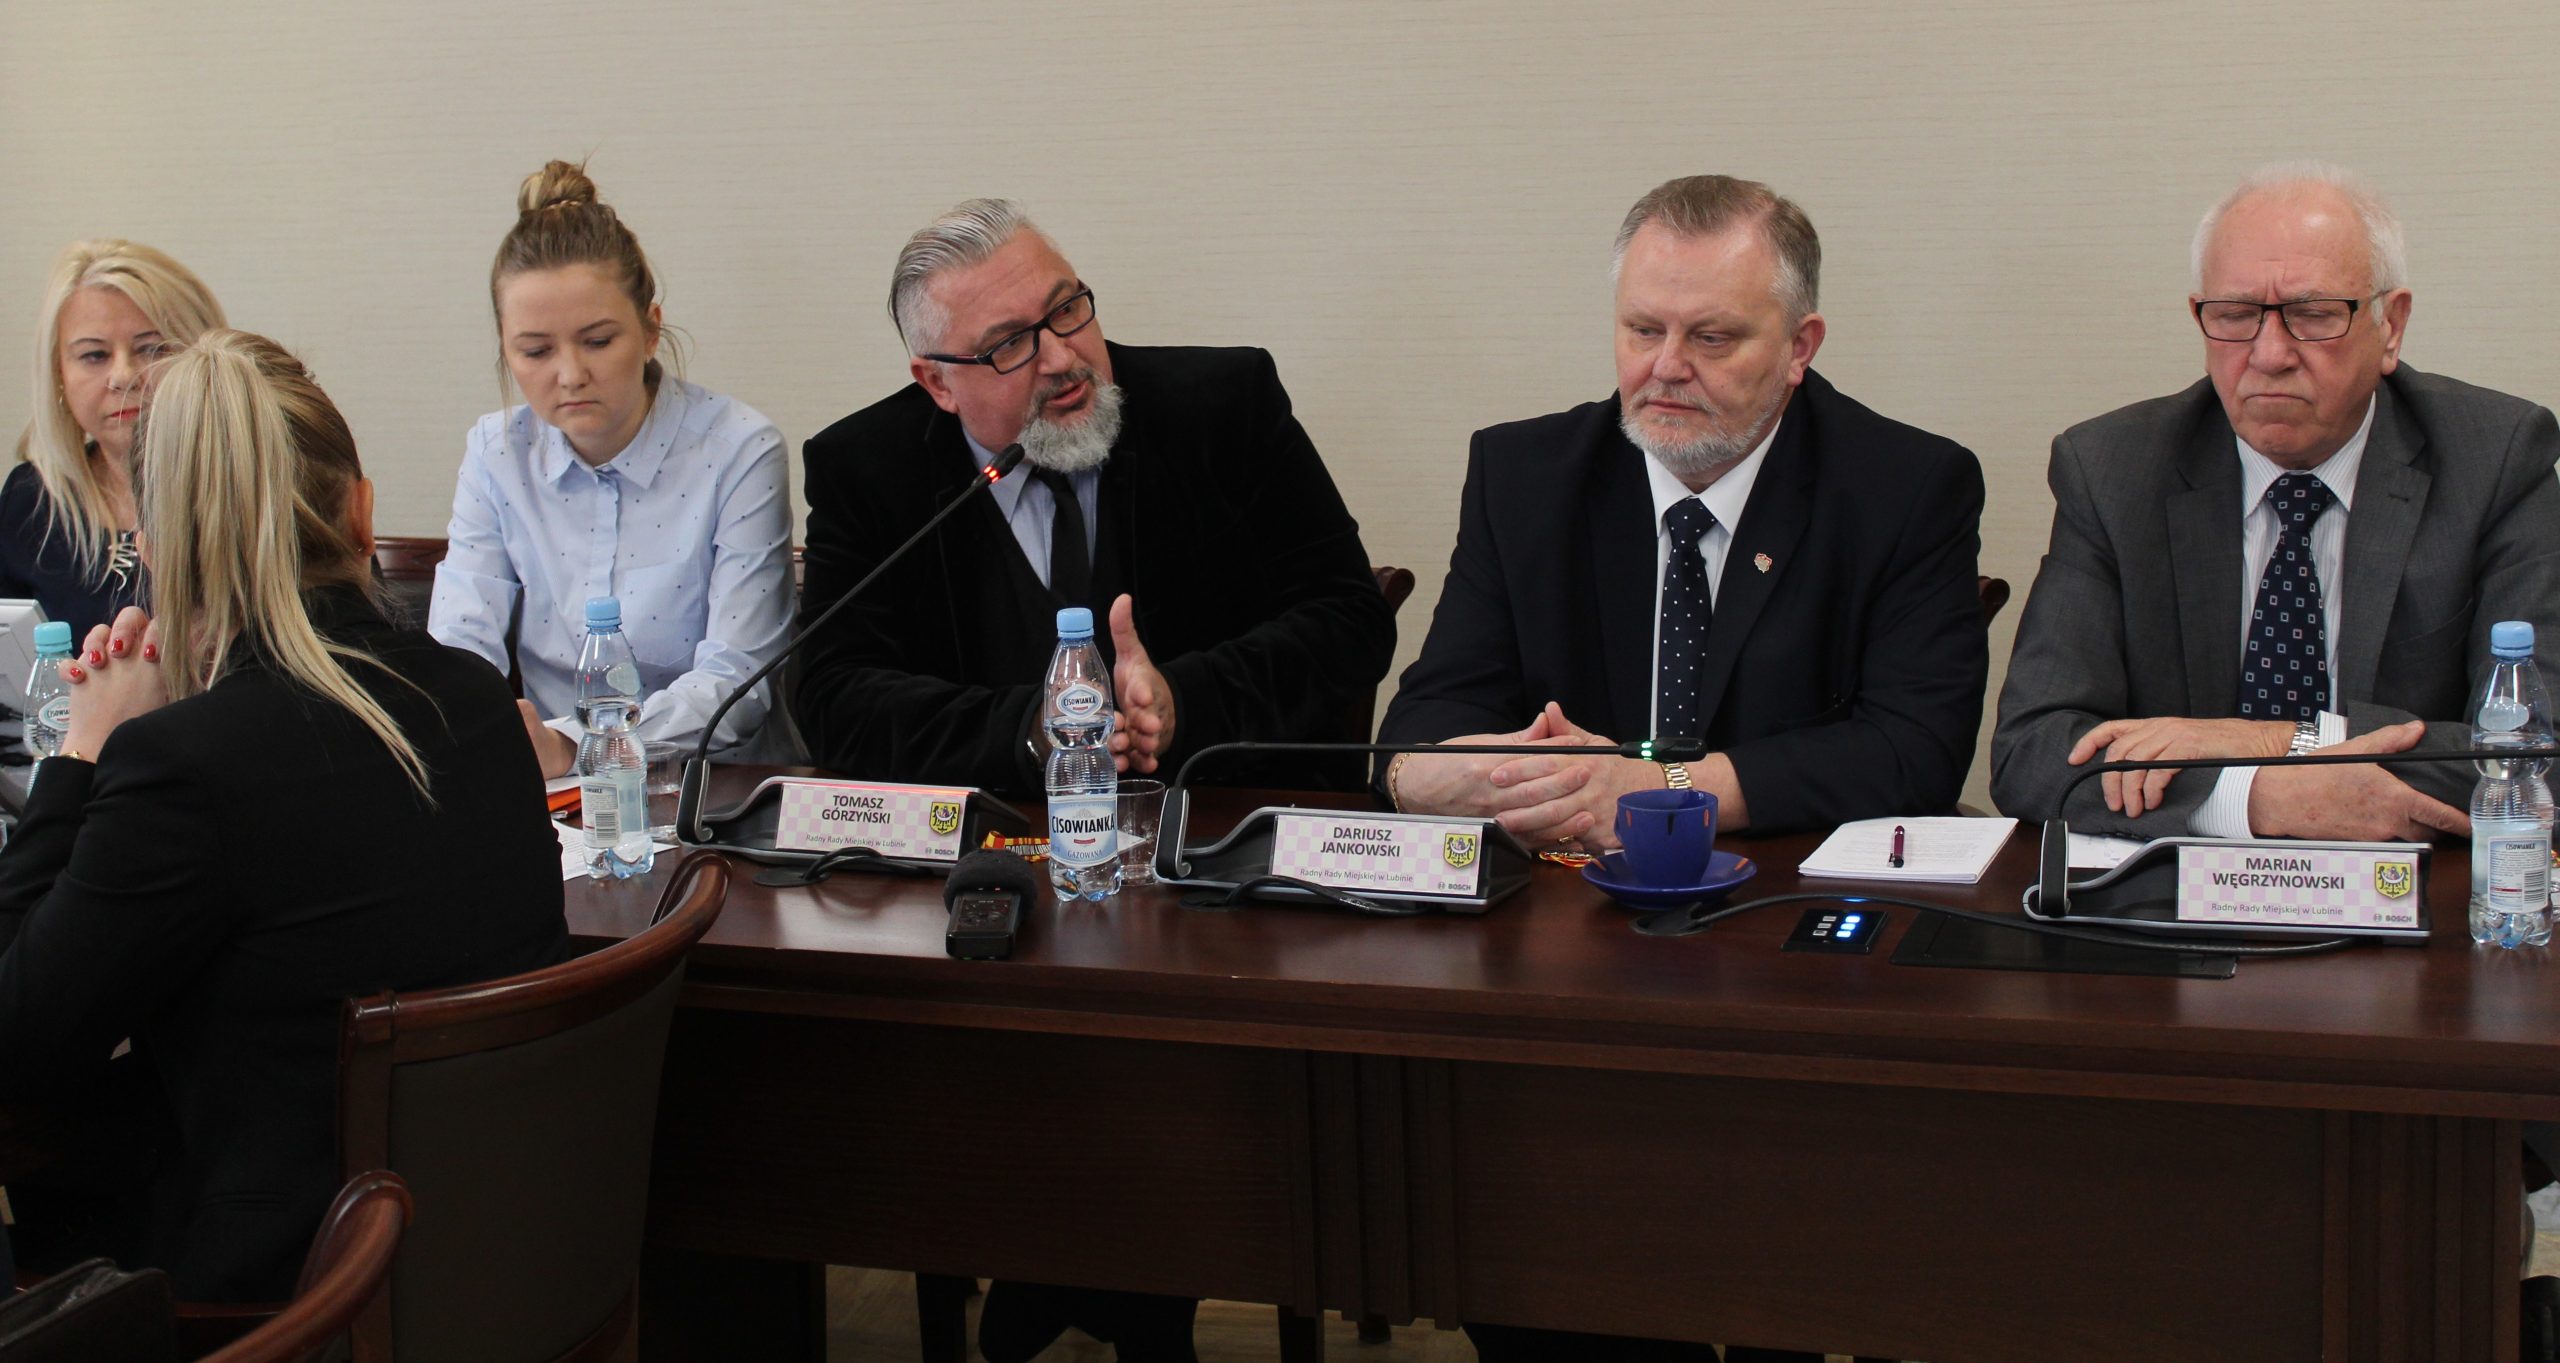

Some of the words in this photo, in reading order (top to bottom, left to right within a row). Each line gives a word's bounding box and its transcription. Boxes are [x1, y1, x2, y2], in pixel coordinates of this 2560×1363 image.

[1063, 696, 1097, 706] CISOWIANKA
[47, 709, 70, 718] CISOWIA
[832, 795, 884, 809] TOMASZ
[821, 807, 890, 825] GÓRZYŃSKI
[1051, 813, 1115, 833] CISOWIANKA
[806, 834, 826, 843] Radny
[827, 836, 843, 845] Rady
[844, 837, 874, 847] Miejskiej
[882, 840, 906, 848] Lubinie
[1333, 827, 1392, 842] DARIUSZ
[1067, 849, 1103, 859] GAZOWANA
[1320, 841, 1400, 858] JANKOWSKI
[2245, 857, 2312, 872] MARIAN
[1300, 868, 1323, 878] Radny
[1324, 870, 1342, 879] Rady
[1344, 871, 1377, 881] Miejskiej
[1386, 873, 1414, 882] Lubinie
[2212, 872, 2345, 890] WĘGRZYNOWSKI
[2211, 903, 2238, 913] Radny
[2239, 904, 2261, 914] Rady
[2262, 905, 2300, 915] Miejskiej
[2311, 906, 2344, 915] Lubinie
